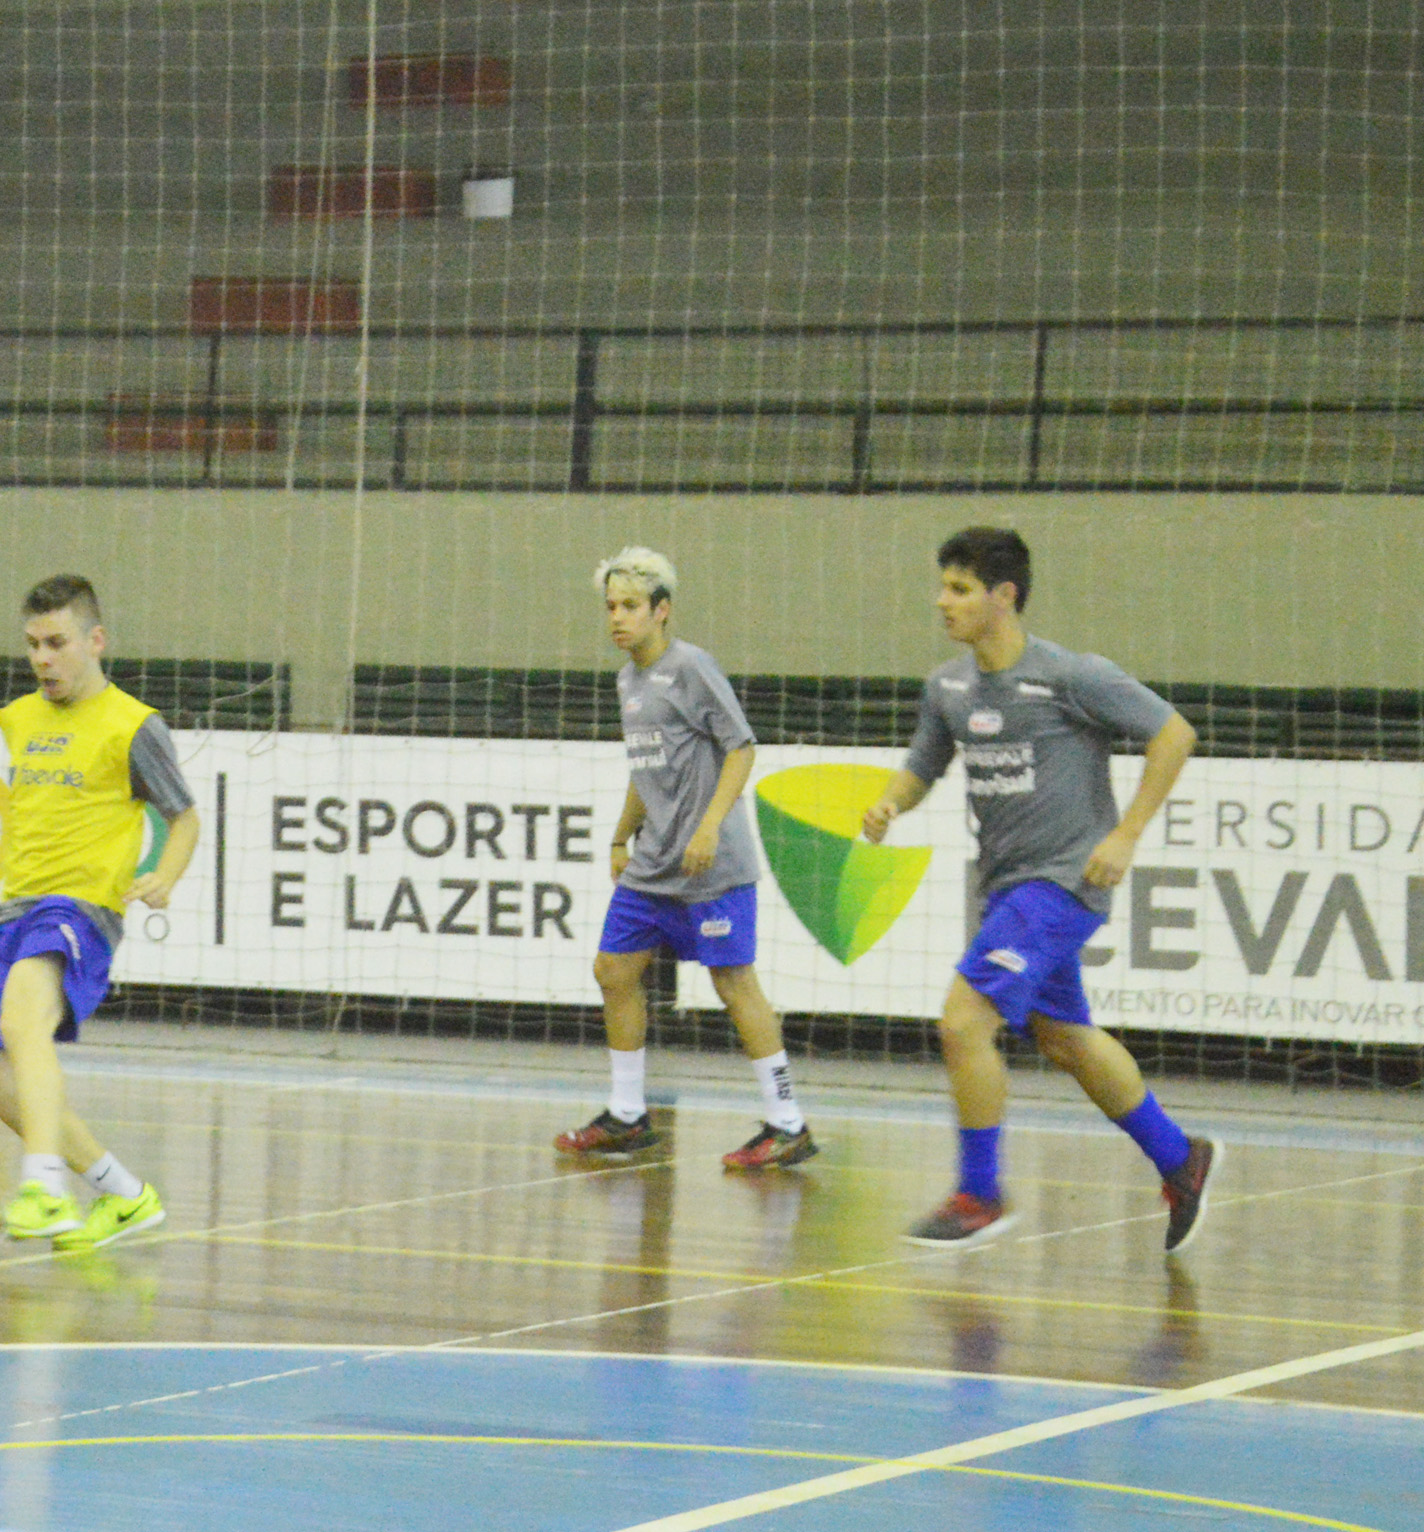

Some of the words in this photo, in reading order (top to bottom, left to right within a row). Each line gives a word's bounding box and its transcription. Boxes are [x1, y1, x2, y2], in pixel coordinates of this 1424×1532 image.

[273, 796, 594, 863] ESPORTE
[271, 871, 306, 928] E
[344, 874, 574, 939] LAZER
[1090, 988, 1195, 1016] MENTO
[1204, 994, 1283, 1022] PARA
[1291, 999, 1406, 1027] INOVAR
